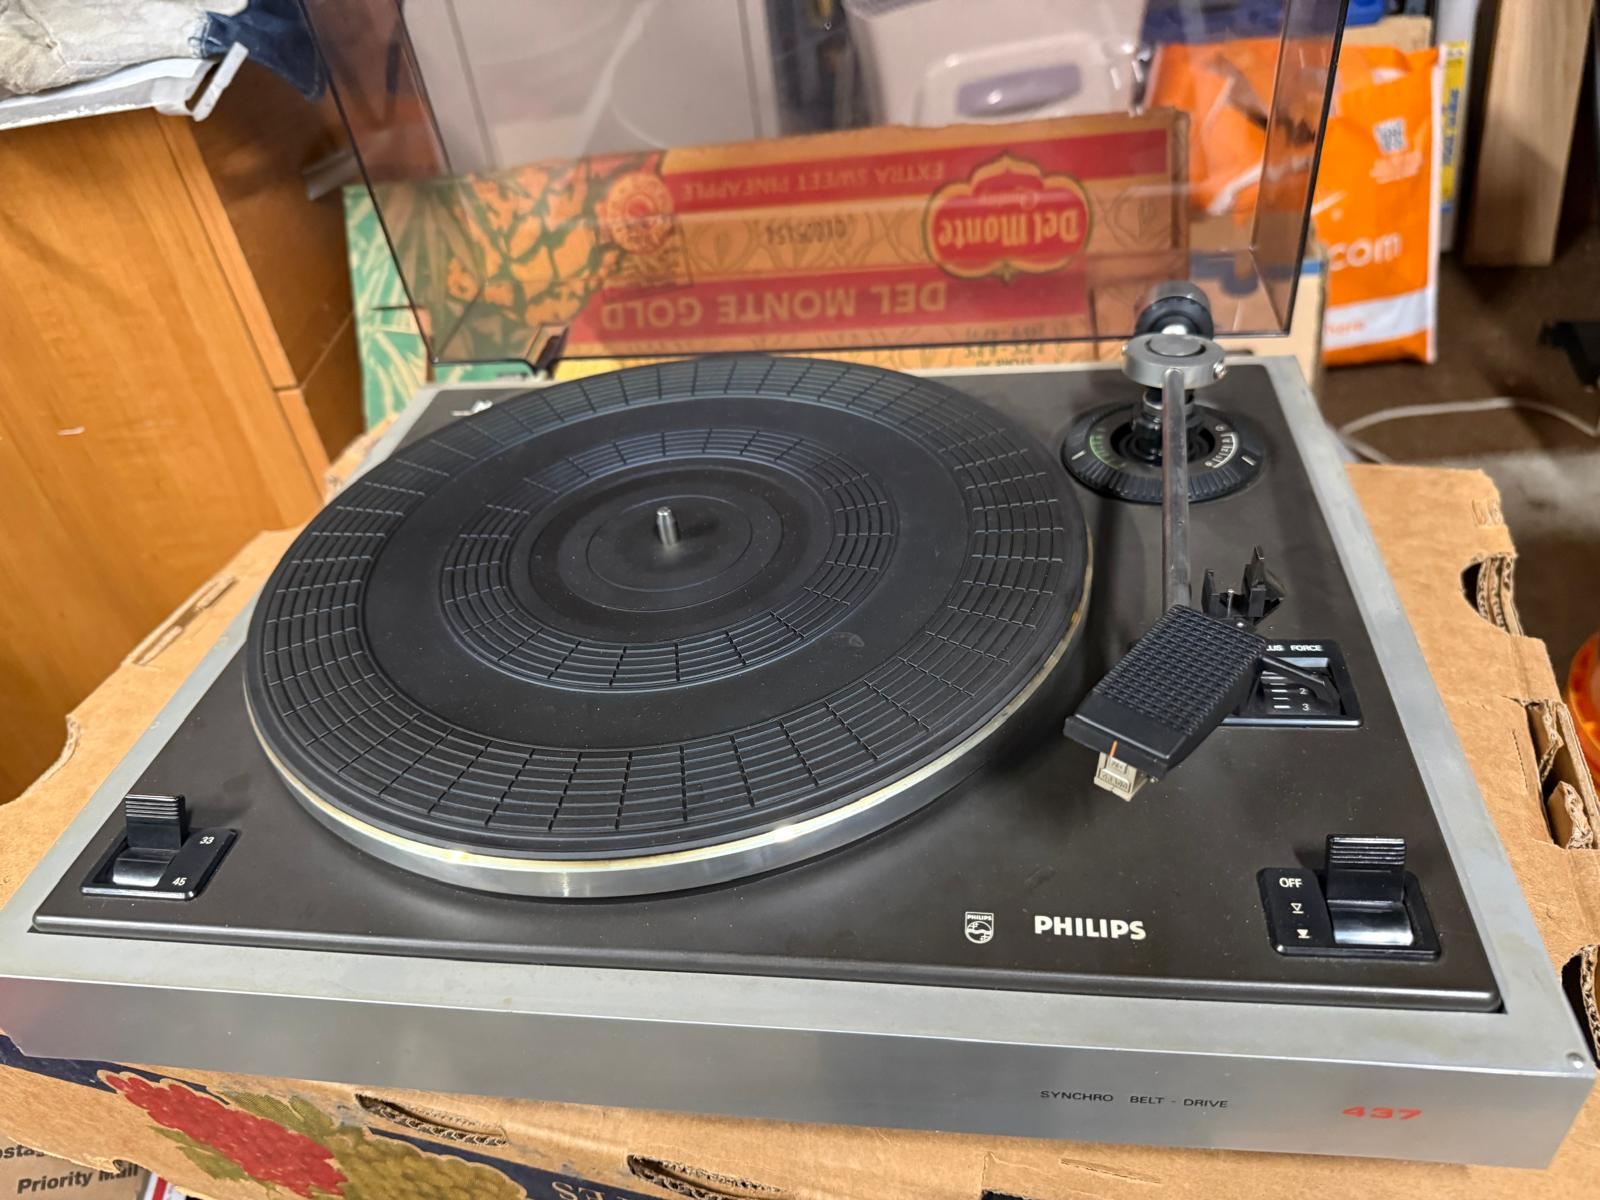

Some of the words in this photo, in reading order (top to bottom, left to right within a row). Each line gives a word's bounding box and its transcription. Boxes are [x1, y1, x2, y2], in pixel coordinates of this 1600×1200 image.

[798, 167, 869, 193] SWEET
[874, 160, 944, 187] EXTRA
[683, 176, 790, 203] PINEAPPLE
[937, 212, 1028, 251] Monte
[1033, 208, 1081, 246] Del
[718, 287, 857, 326] MONTE
[871, 280, 947, 316] DEL
[601, 296, 704, 332] GOLD
[1289, 644, 1324, 652] FORCE
[1299, 687, 1308, 695] 2
[1302, 703, 1311, 712] 3
[200, 836, 215, 845] 33
[172, 877, 187, 886] 45
[1279, 877, 1303, 889] OFF
[967, 913, 993, 922] PHILIPS
[1034, 914, 1147, 941] PHILIPS
[1040, 1090, 1115, 1103] SYNCHRO
[1130, 1095, 1165, 1105] BELT
[1183, 1098, 1229, 1109] DRIVE
[1343, 1106, 1422, 1120] 437
[17, 1171, 93, 1194] Priority
